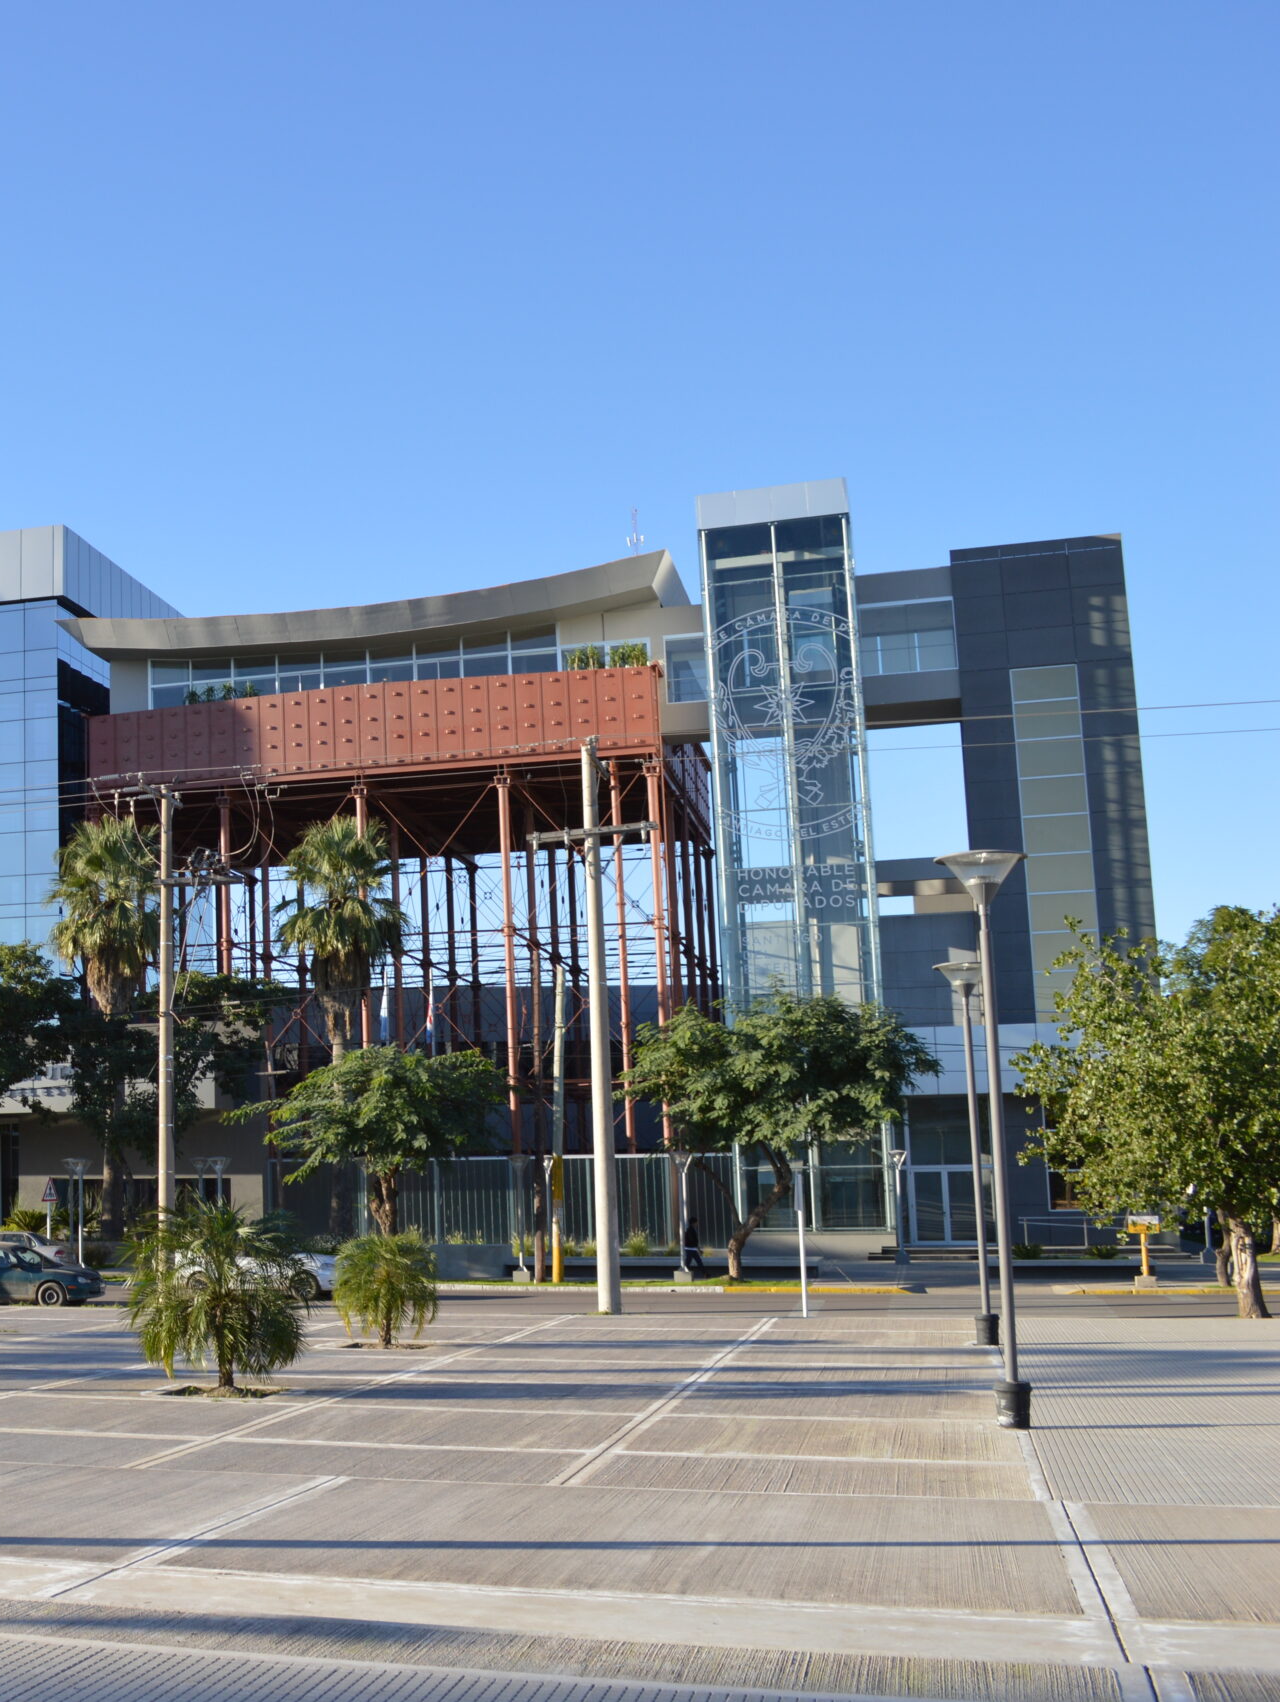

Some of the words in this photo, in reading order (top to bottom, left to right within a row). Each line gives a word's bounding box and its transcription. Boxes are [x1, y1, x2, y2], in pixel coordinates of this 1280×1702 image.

[811, 613, 831, 625] DE
[737, 863, 855, 880] HONORABLE
[738, 880, 822, 897] CAMARA
[831, 878, 857, 892] DE
[738, 894, 856, 913] DIPUTADOS
